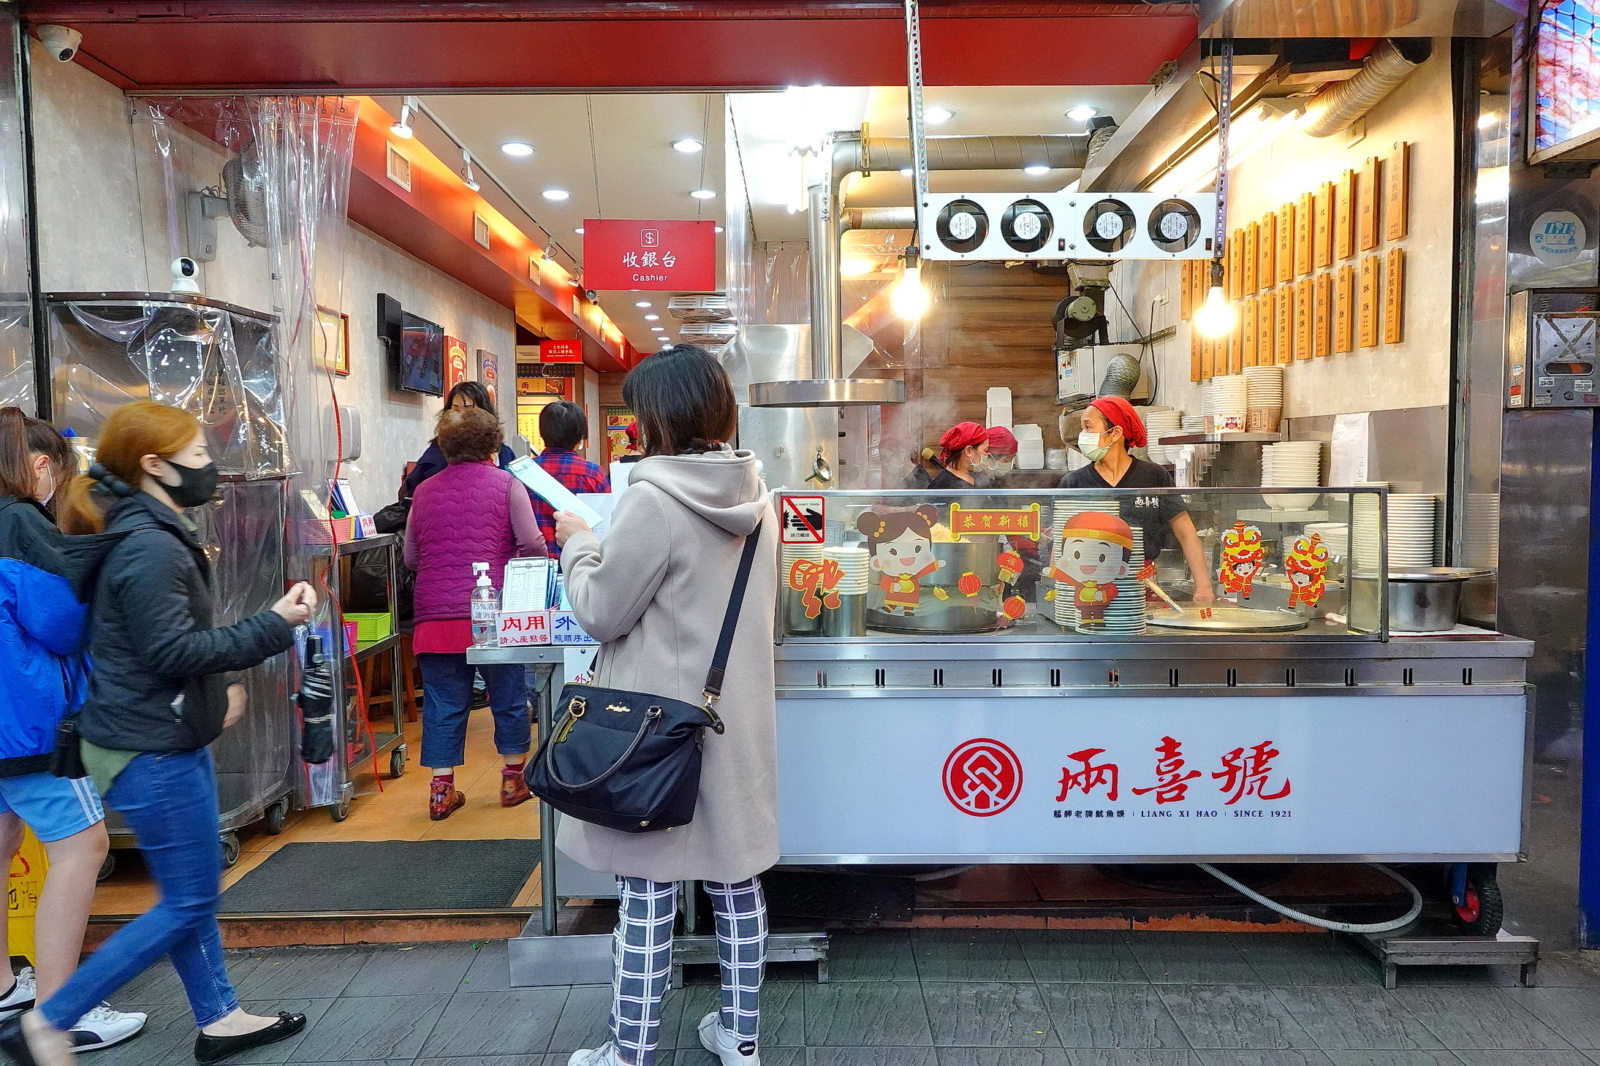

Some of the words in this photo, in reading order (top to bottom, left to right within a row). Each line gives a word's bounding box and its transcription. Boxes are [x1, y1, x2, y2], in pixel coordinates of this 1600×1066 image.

[622, 250, 676, 269] 收銀台
[632, 273, 668, 282] Cashier
[501, 615, 545, 632] 內用
[554, 615, 577, 631] 外
[554, 634, 597, 643] 照順序出
[1055, 735, 1292, 806] 兩喜號
[1141, 810, 1173, 818] LIANG
[1178, 810, 1189, 818] XI
[1196, 810, 1218, 818] HAO
[1233, 810, 1264, 818] SINCE
[1269, 810, 1292, 818] 1921
